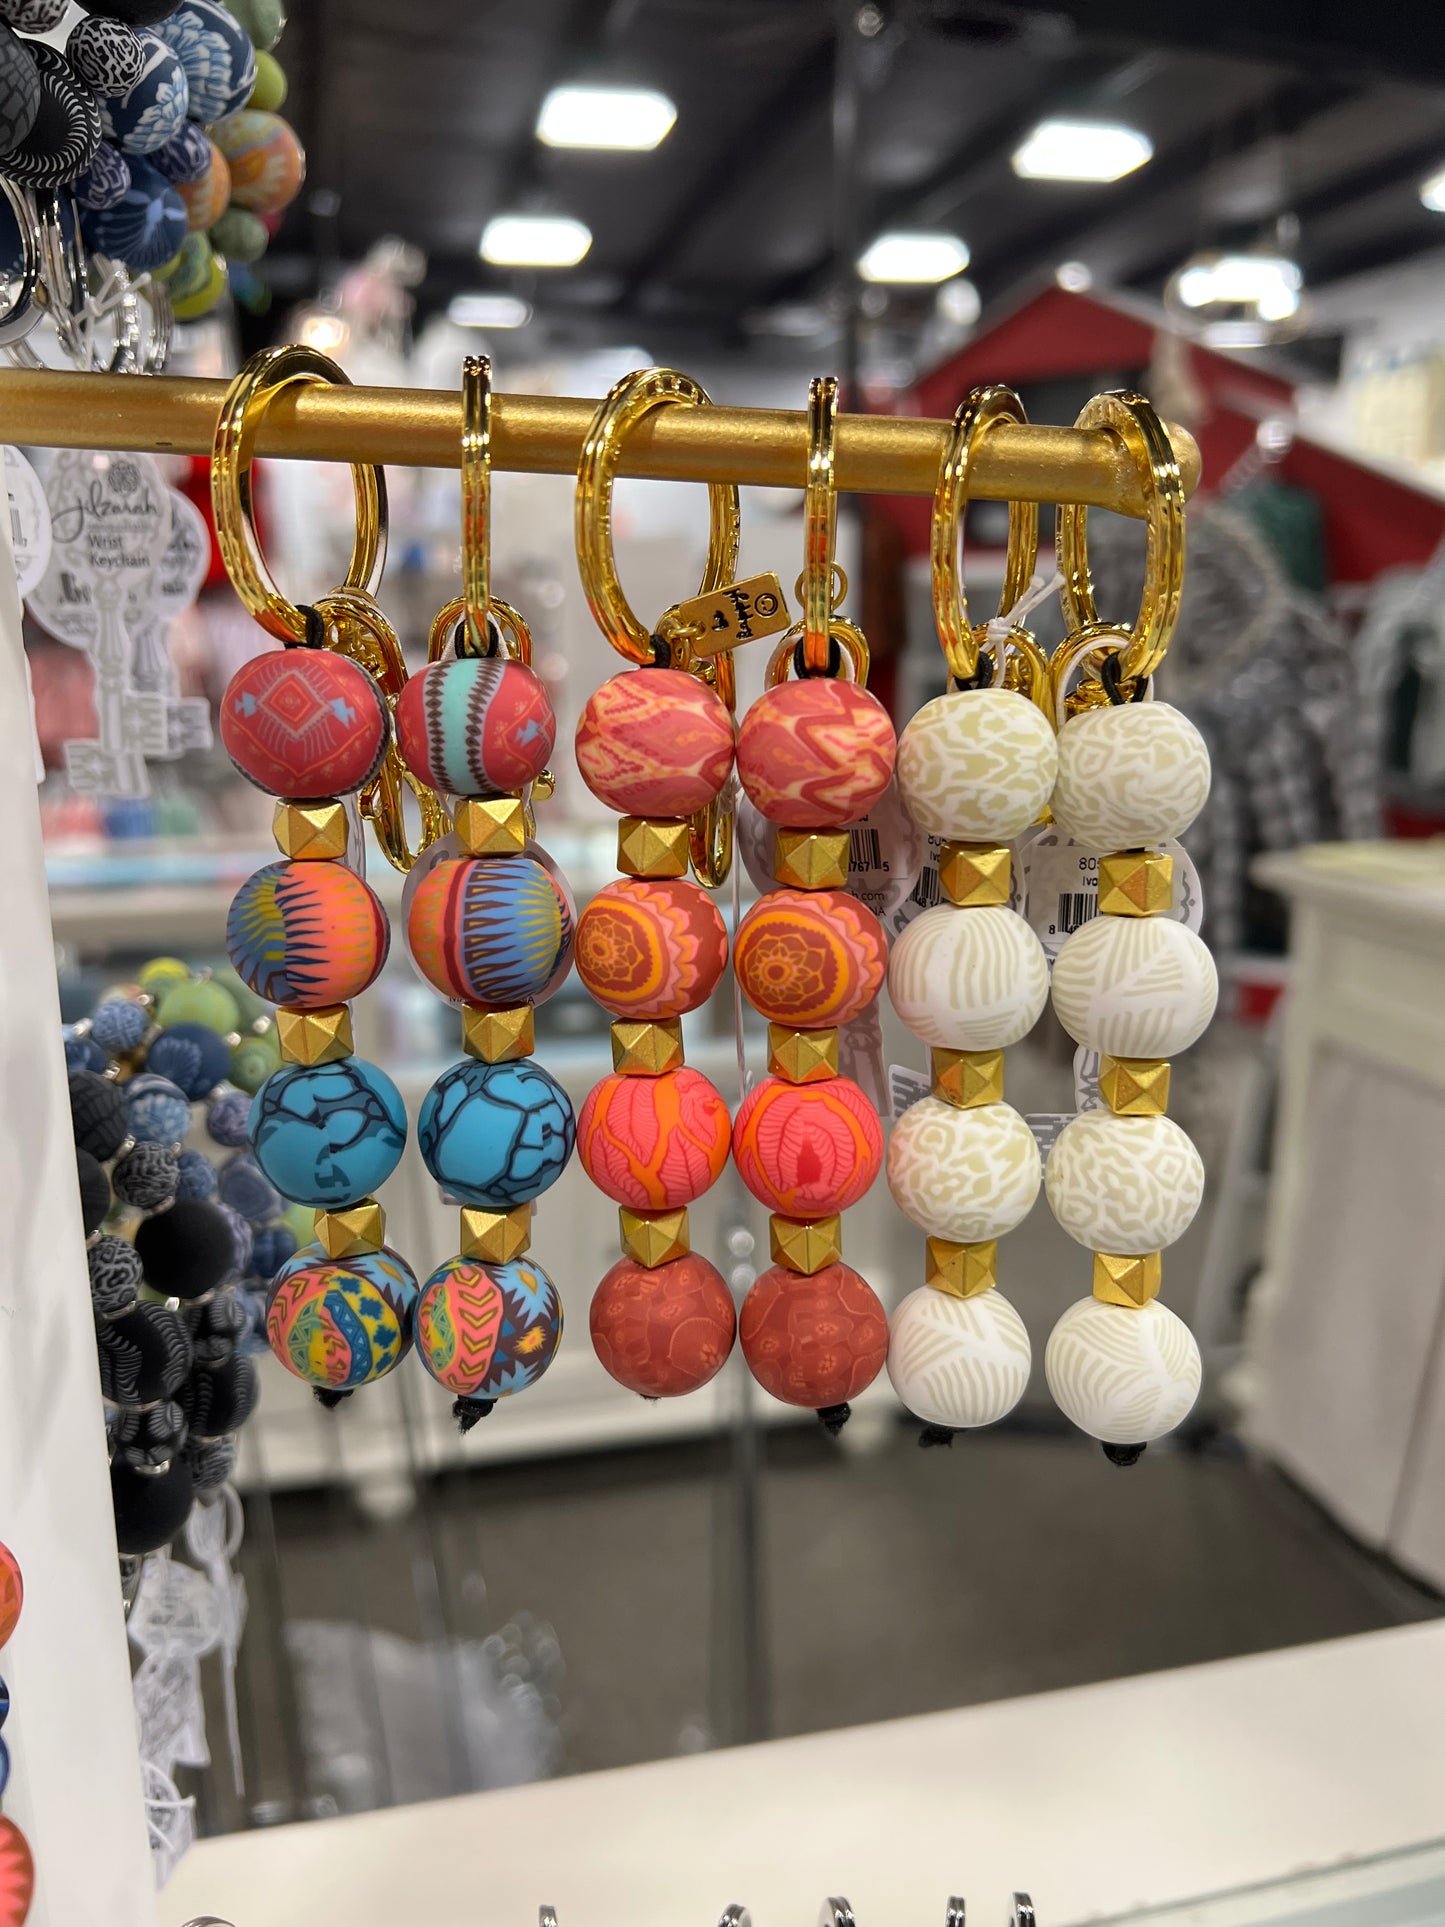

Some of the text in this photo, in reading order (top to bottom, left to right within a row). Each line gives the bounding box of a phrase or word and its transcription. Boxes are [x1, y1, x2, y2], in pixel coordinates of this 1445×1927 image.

[88, 534, 122, 548] Wrist
[90, 553, 150, 570] Keychain
[882, 861, 890, 872] 5
